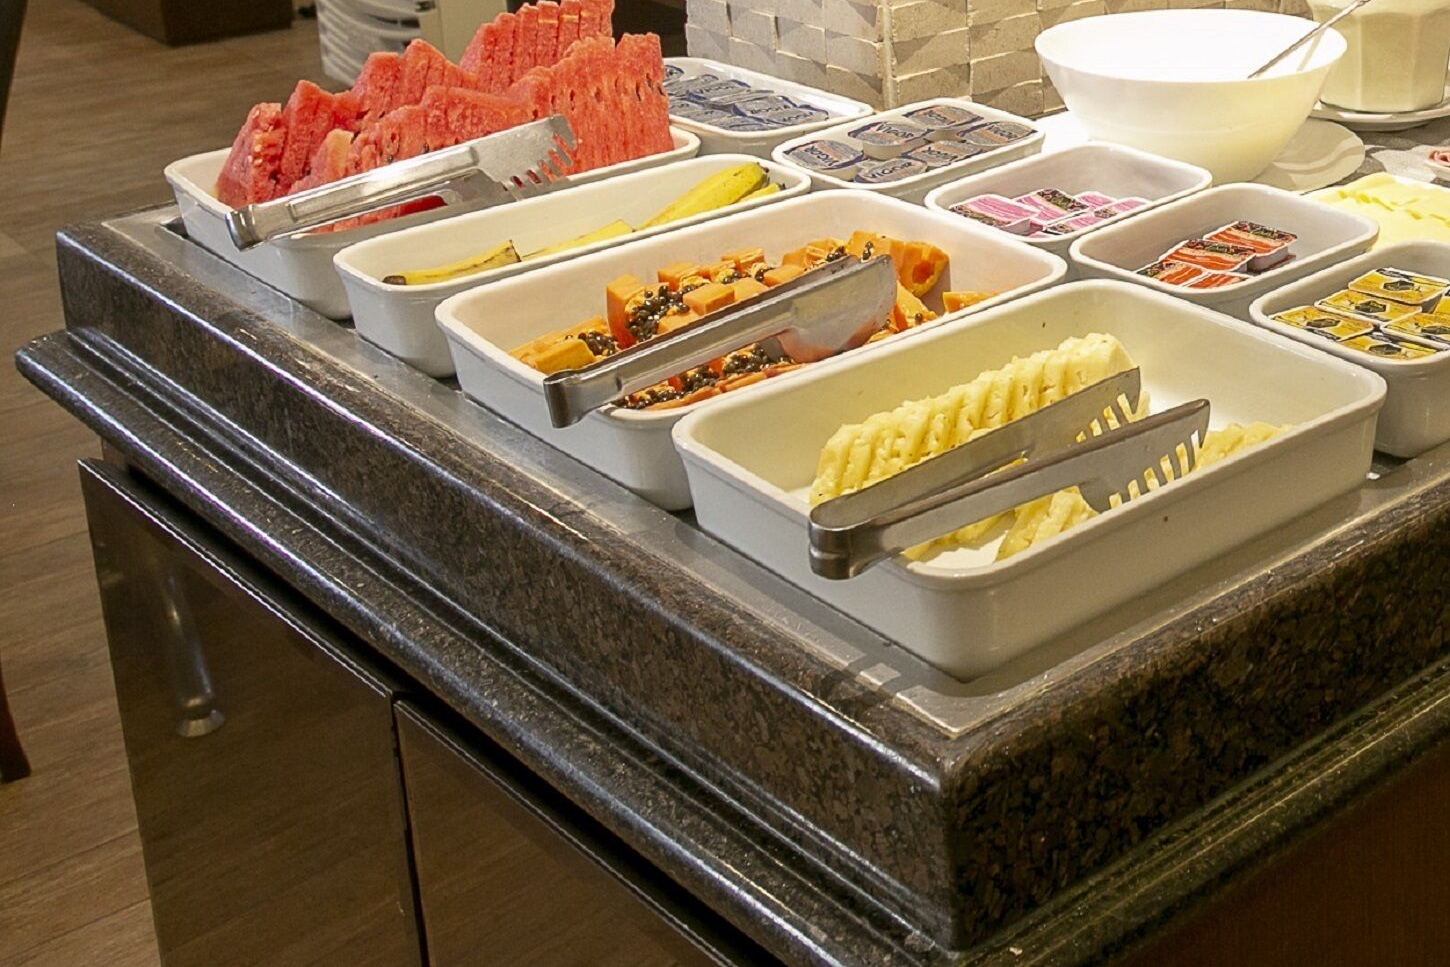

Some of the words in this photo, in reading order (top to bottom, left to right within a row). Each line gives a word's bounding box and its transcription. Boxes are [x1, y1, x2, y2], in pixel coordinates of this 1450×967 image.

[876, 123, 914, 139] VIGOR
[805, 145, 839, 166] VIGOR
[865, 161, 912, 179] VIGOR
